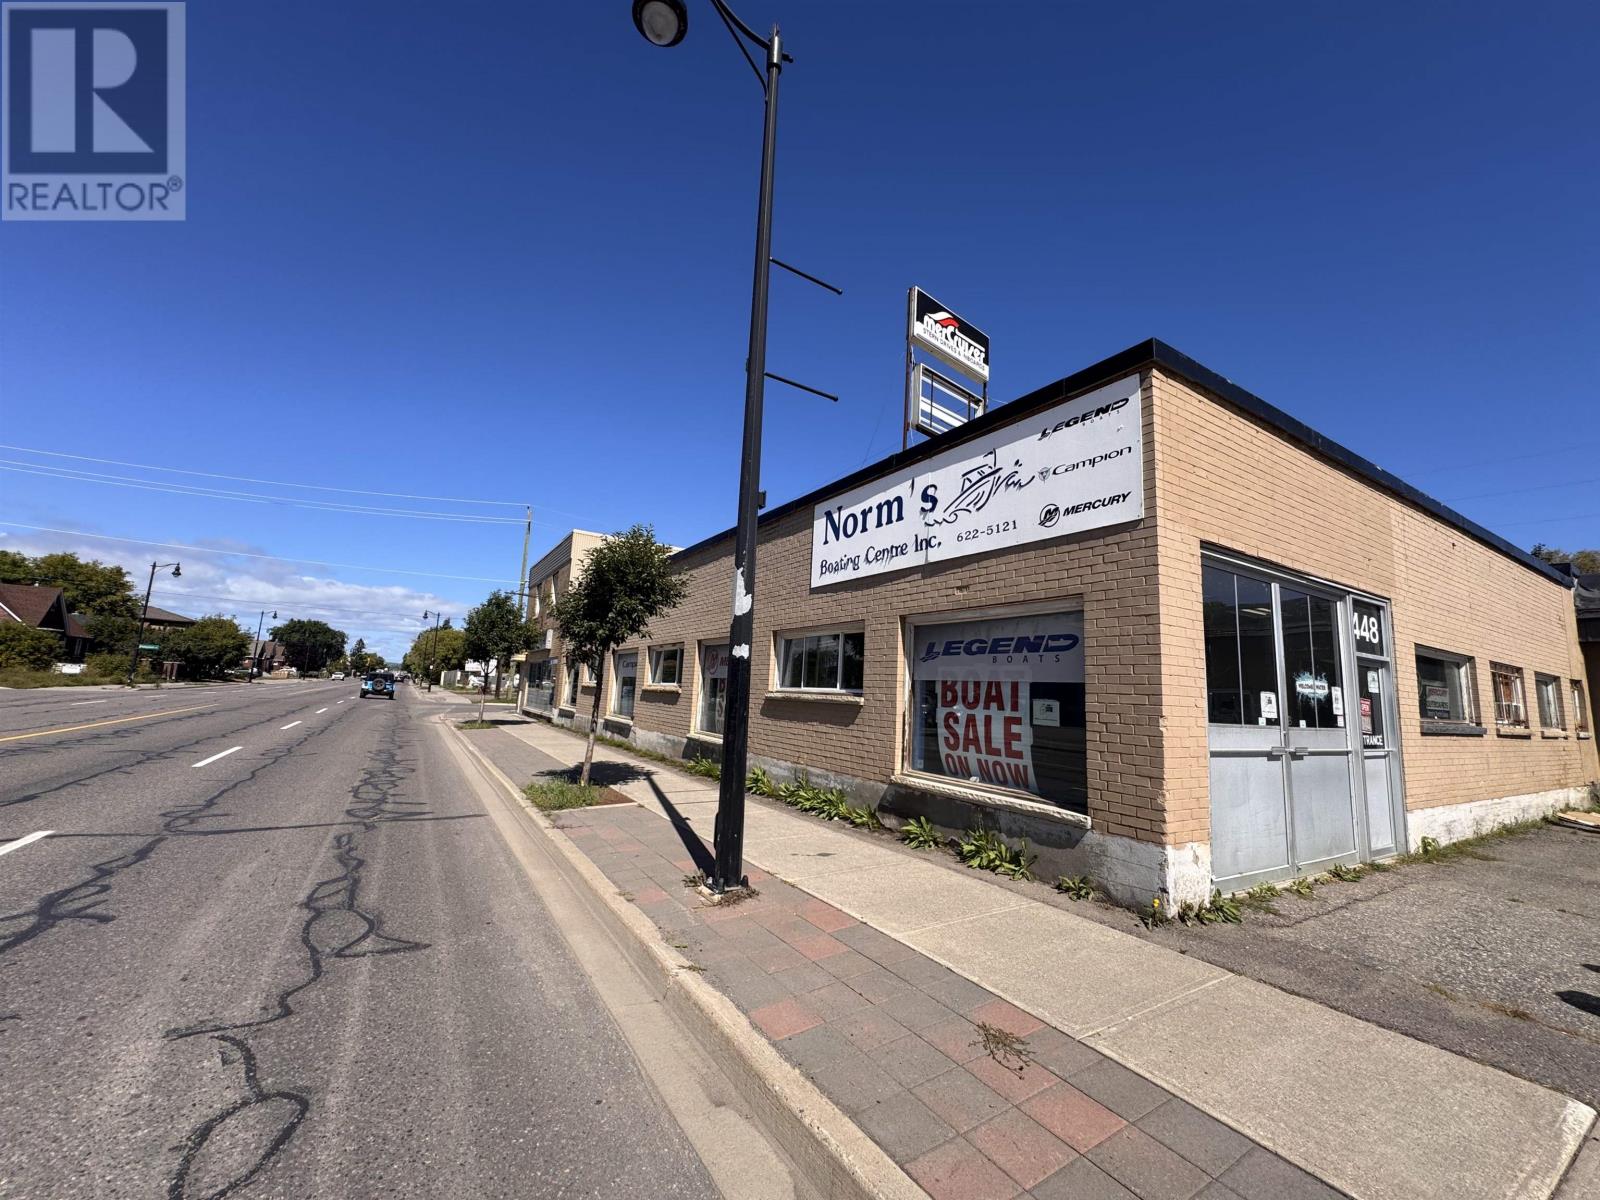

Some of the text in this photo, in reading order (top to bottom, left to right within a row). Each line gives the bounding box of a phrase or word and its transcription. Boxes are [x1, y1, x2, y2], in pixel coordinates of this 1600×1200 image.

[1038, 397, 1129, 441] LEGEND
[1052, 446, 1132, 475] Campion
[822, 477, 938, 545] Norm's
[1063, 491, 1132, 517] MERCURY
[957, 520, 1017, 543] 622-5121
[819, 554, 861, 577] Boating
[865, 545, 908, 566] Centre
[1353, 612, 1380, 644] 448
[920, 633, 1080, 662] LEGEND
[992, 654, 1061, 664] BOATS
[943, 711, 1024, 760] SALE
[1362, 735, 1384, 747] TRANCE
[944, 753, 1030, 789] ON NOW
